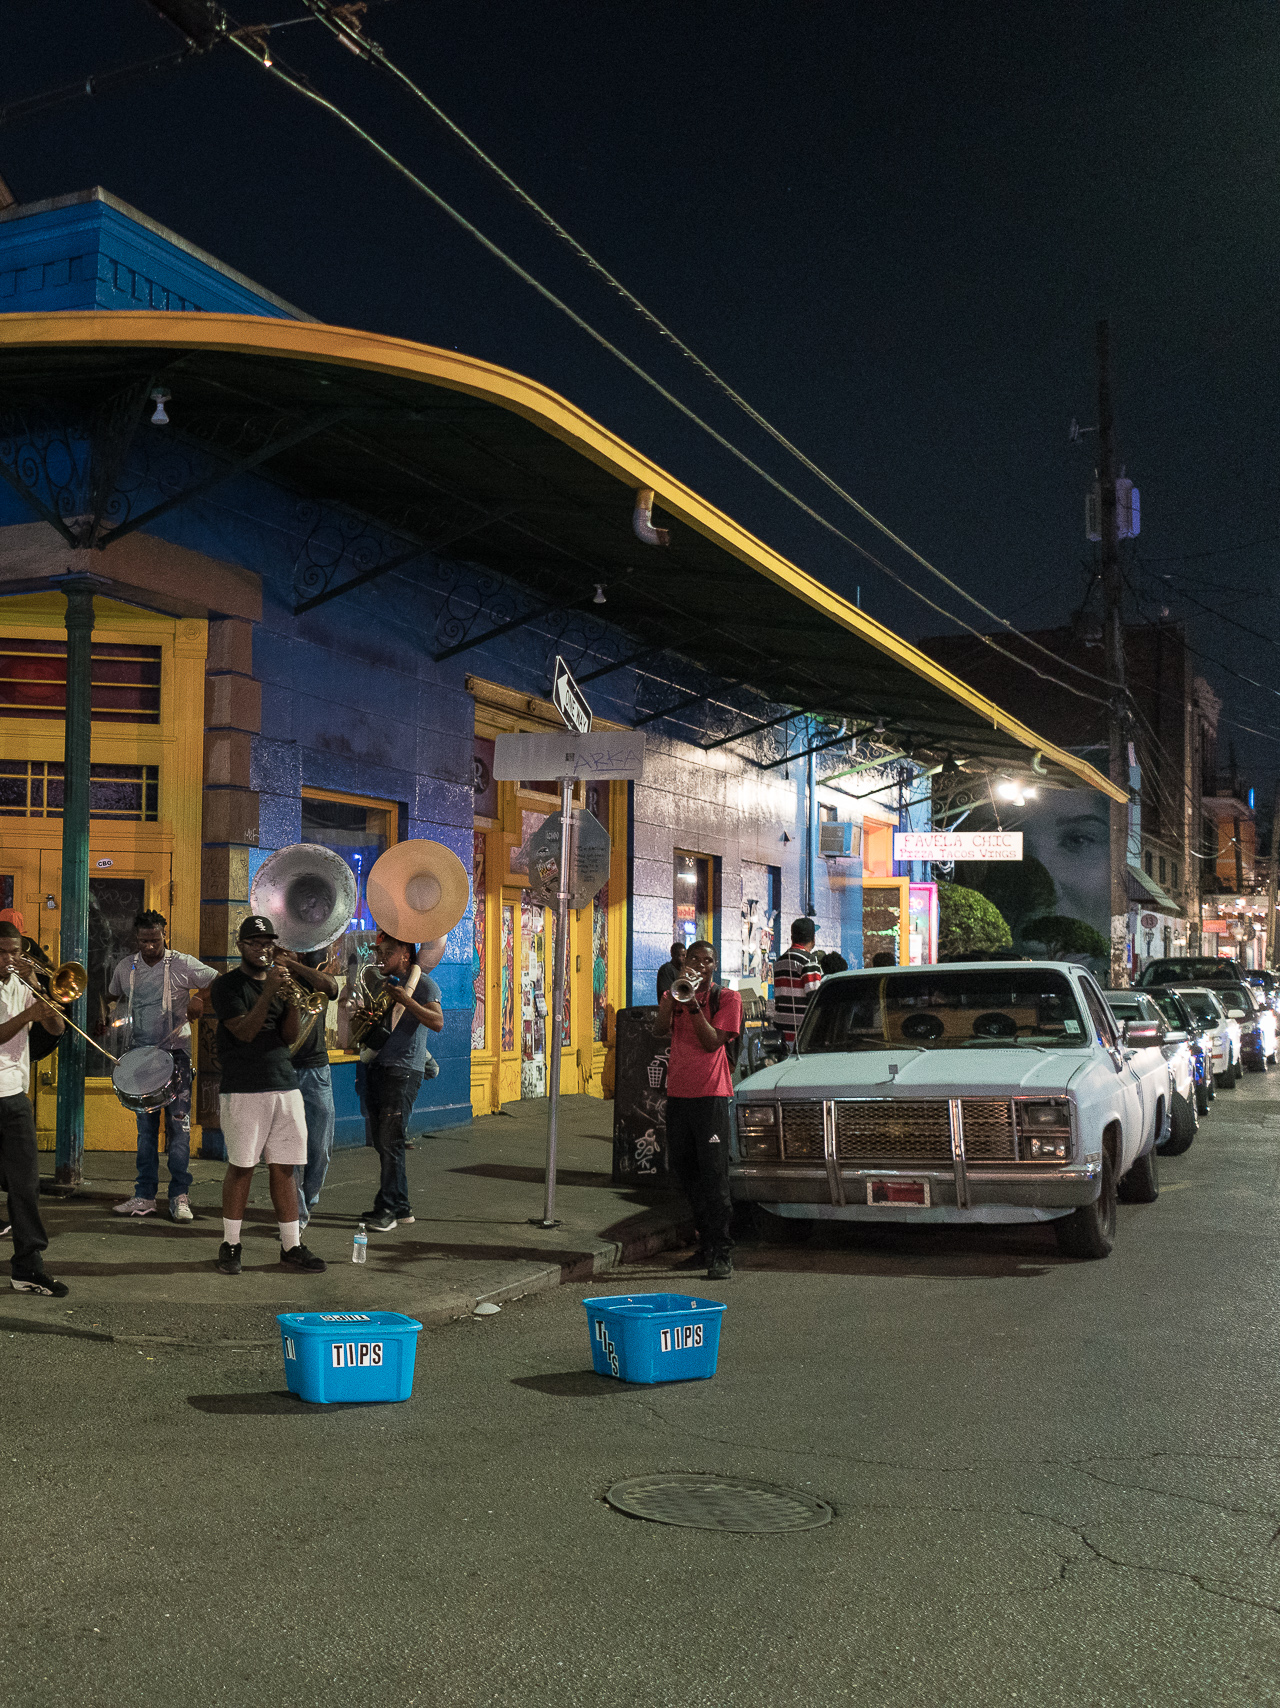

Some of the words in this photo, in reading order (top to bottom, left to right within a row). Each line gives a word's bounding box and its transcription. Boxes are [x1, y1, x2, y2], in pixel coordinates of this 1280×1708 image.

[904, 834, 963, 848] FAVELA
[972, 834, 1012, 847] CHIC
[596, 1320, 618, 1376] TIPS
[661, 1325, 702, 1350] TIPS
[333, 1343, 382, 1366] TIPS
